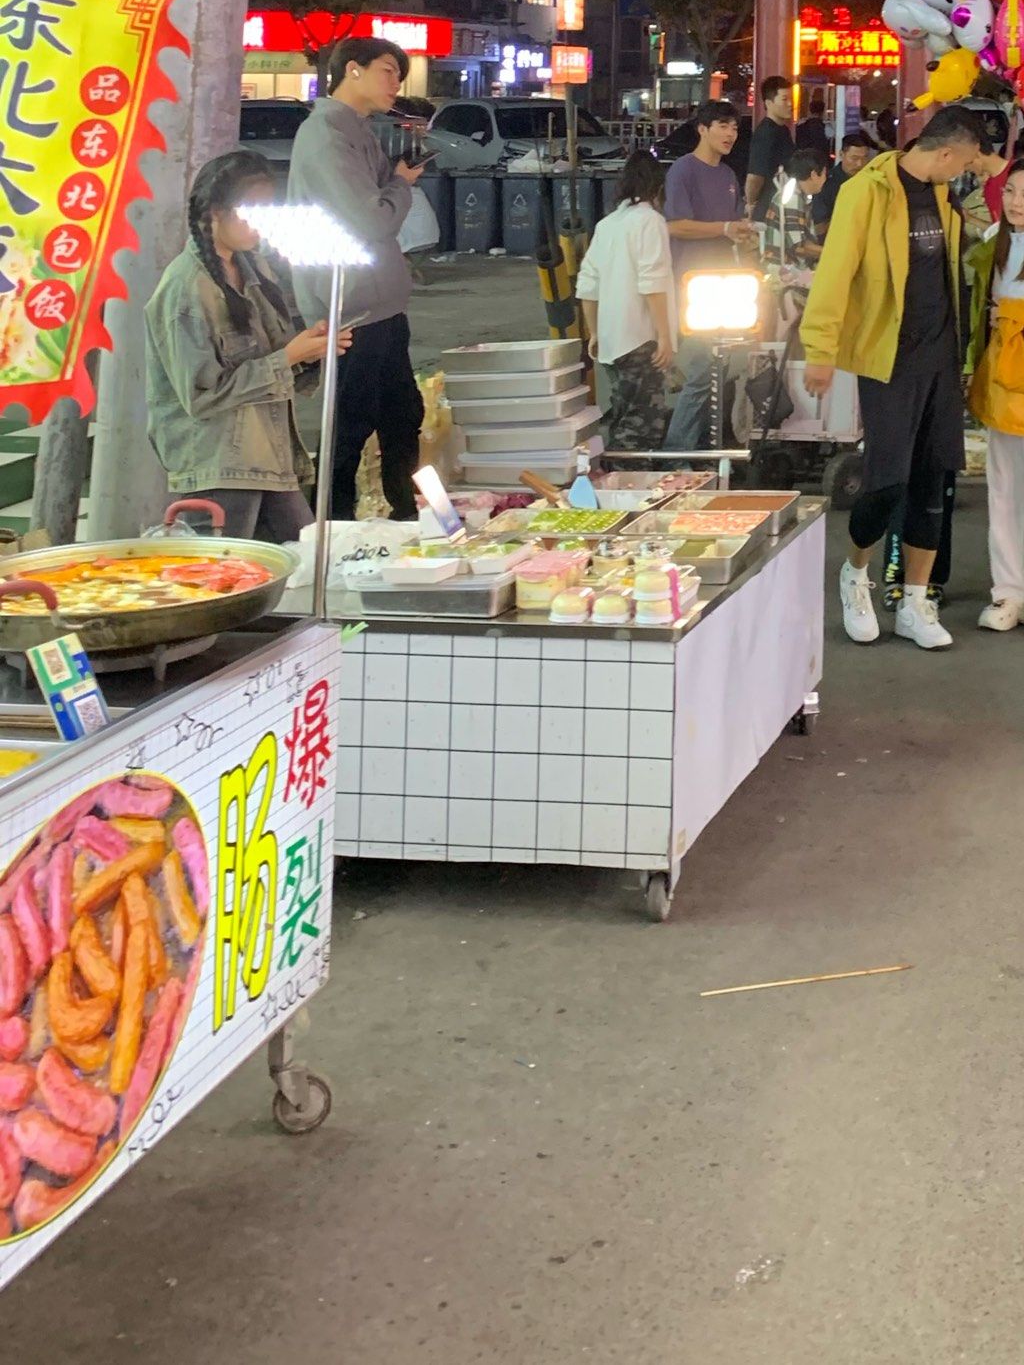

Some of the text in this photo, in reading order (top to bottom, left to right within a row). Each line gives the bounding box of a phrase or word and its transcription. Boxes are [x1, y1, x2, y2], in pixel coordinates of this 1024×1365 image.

[28, 73, 121, 323] 品东北包饭
